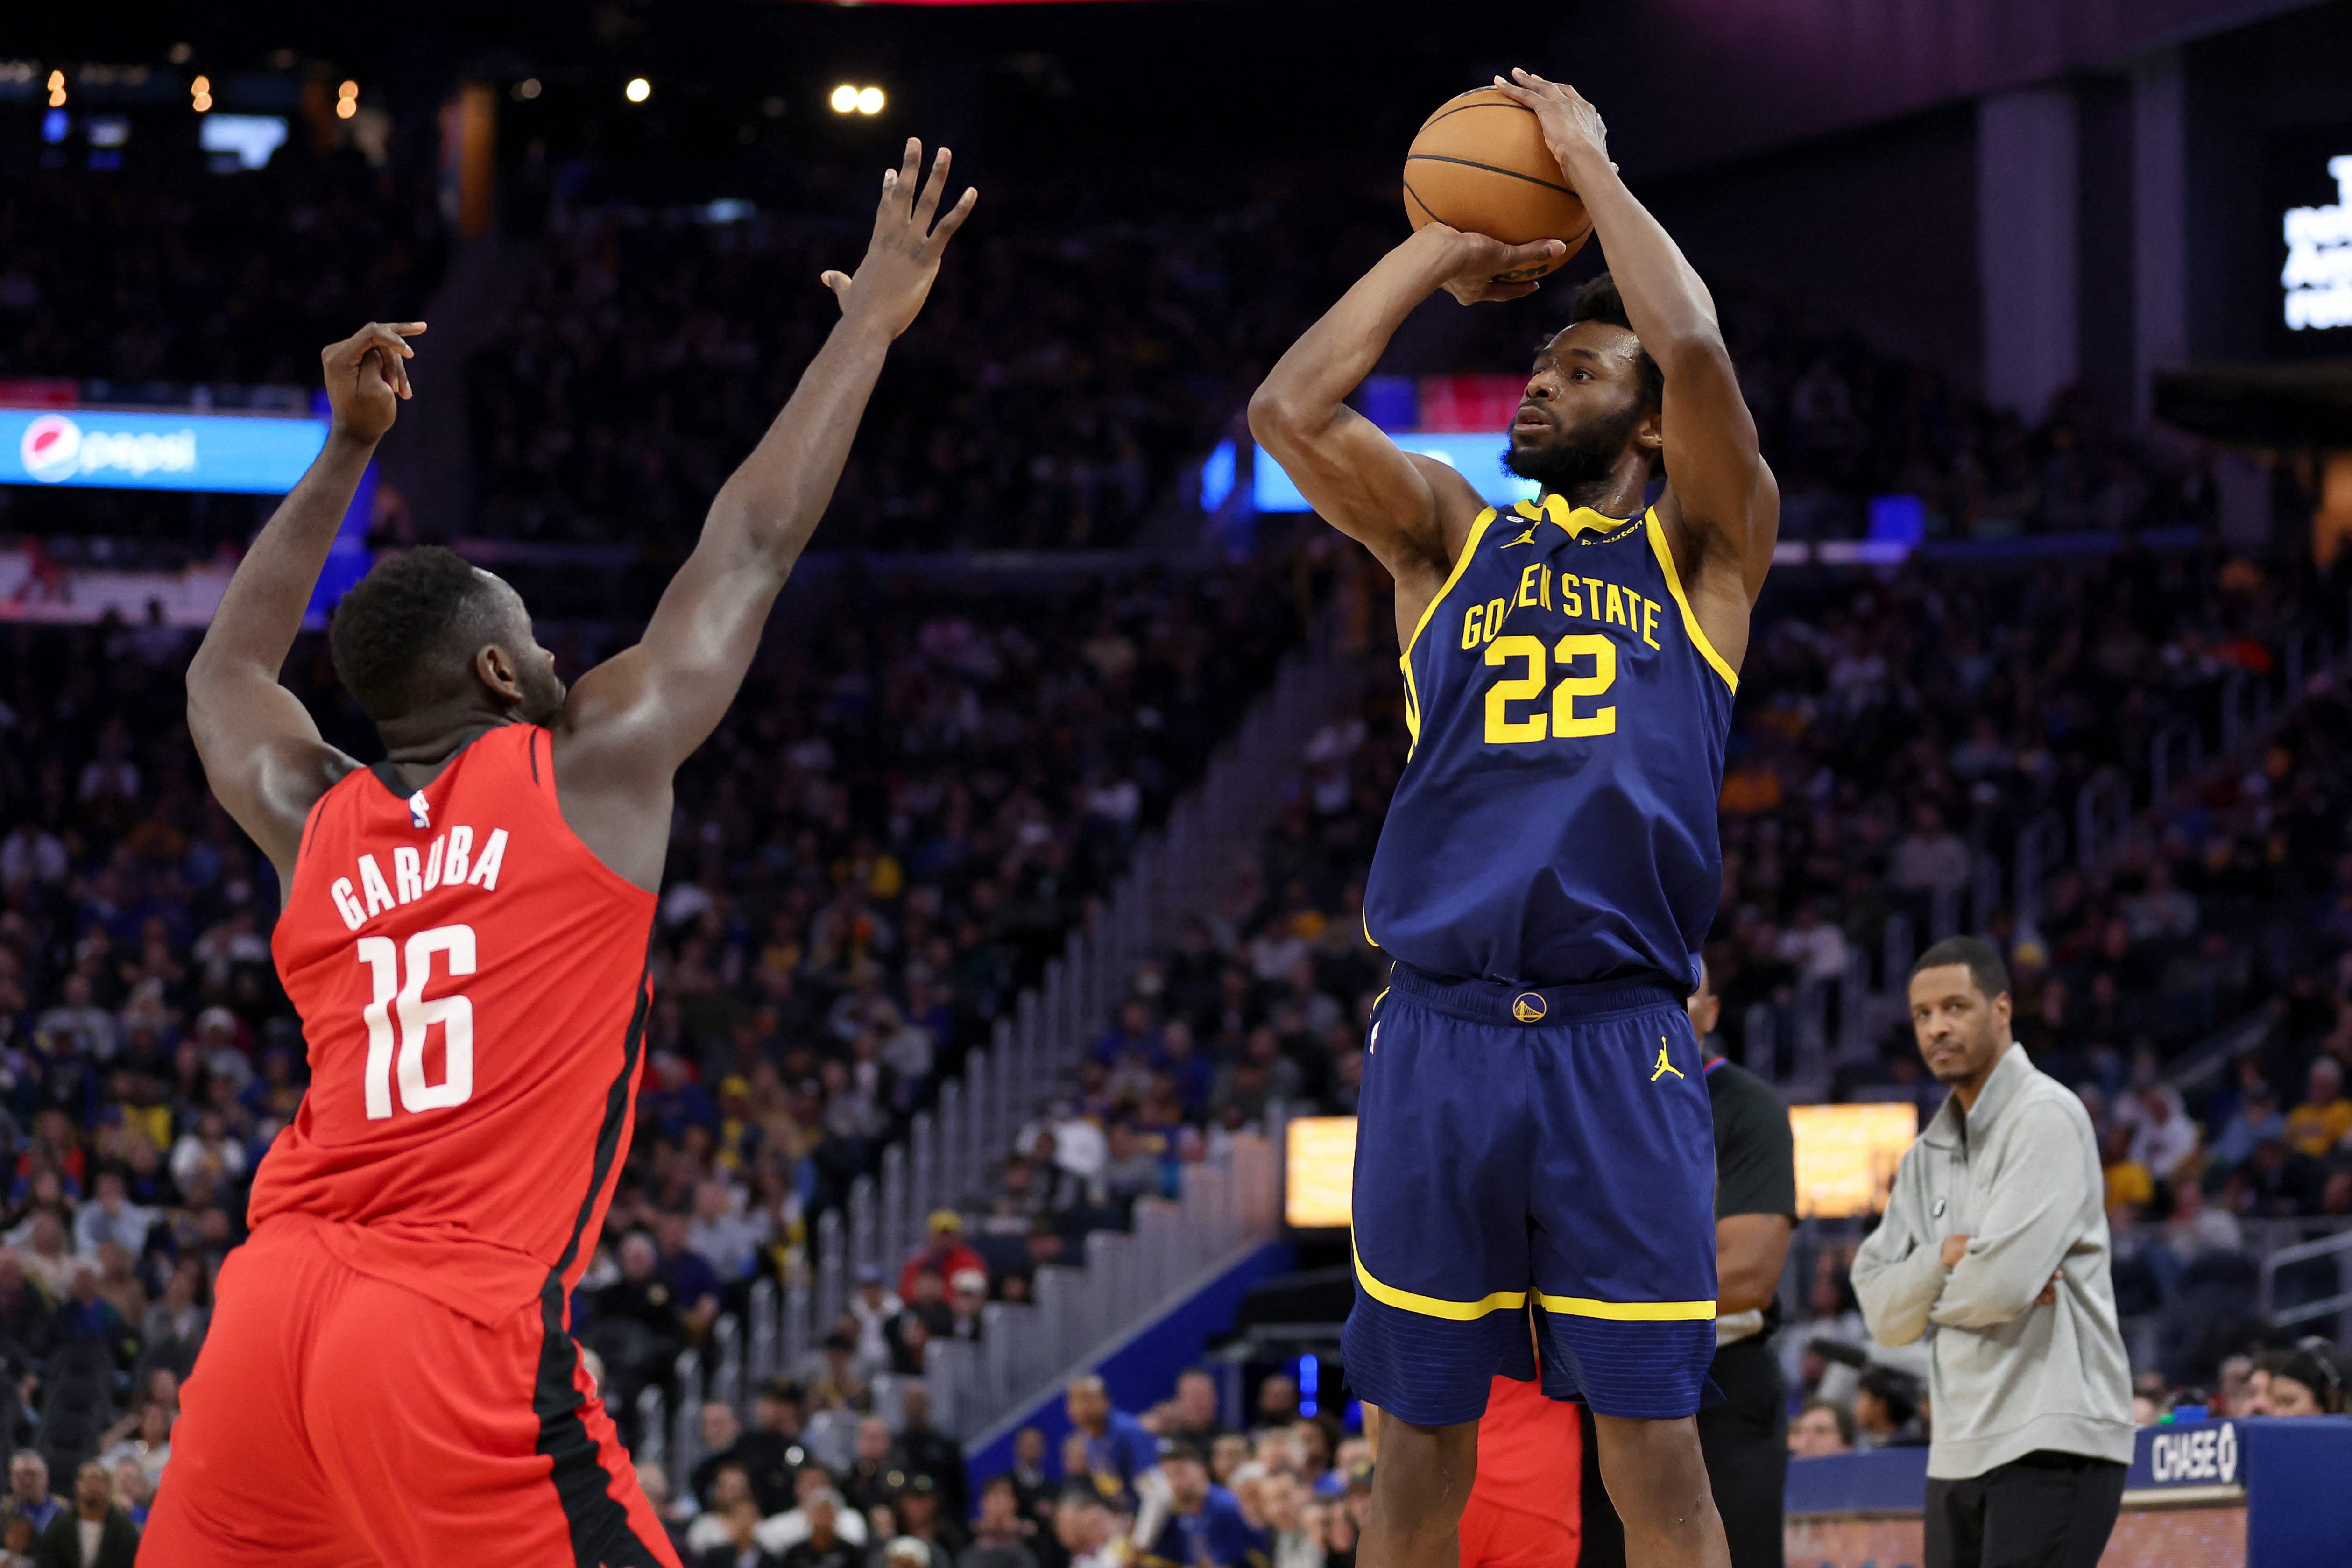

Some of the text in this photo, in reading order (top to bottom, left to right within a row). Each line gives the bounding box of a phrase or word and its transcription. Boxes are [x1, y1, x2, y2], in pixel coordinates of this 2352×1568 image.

[1582, 519, 1643, 546] Rkuten
[1461, 563, 1661, 650] GOEN STATE
[1484, 634, 1616, 744] 22
[331, 826, 509, 931] GARUBA
[358, 924, 476, 1119] 16
[2152, 1430, 2218, 1483] CHASE
